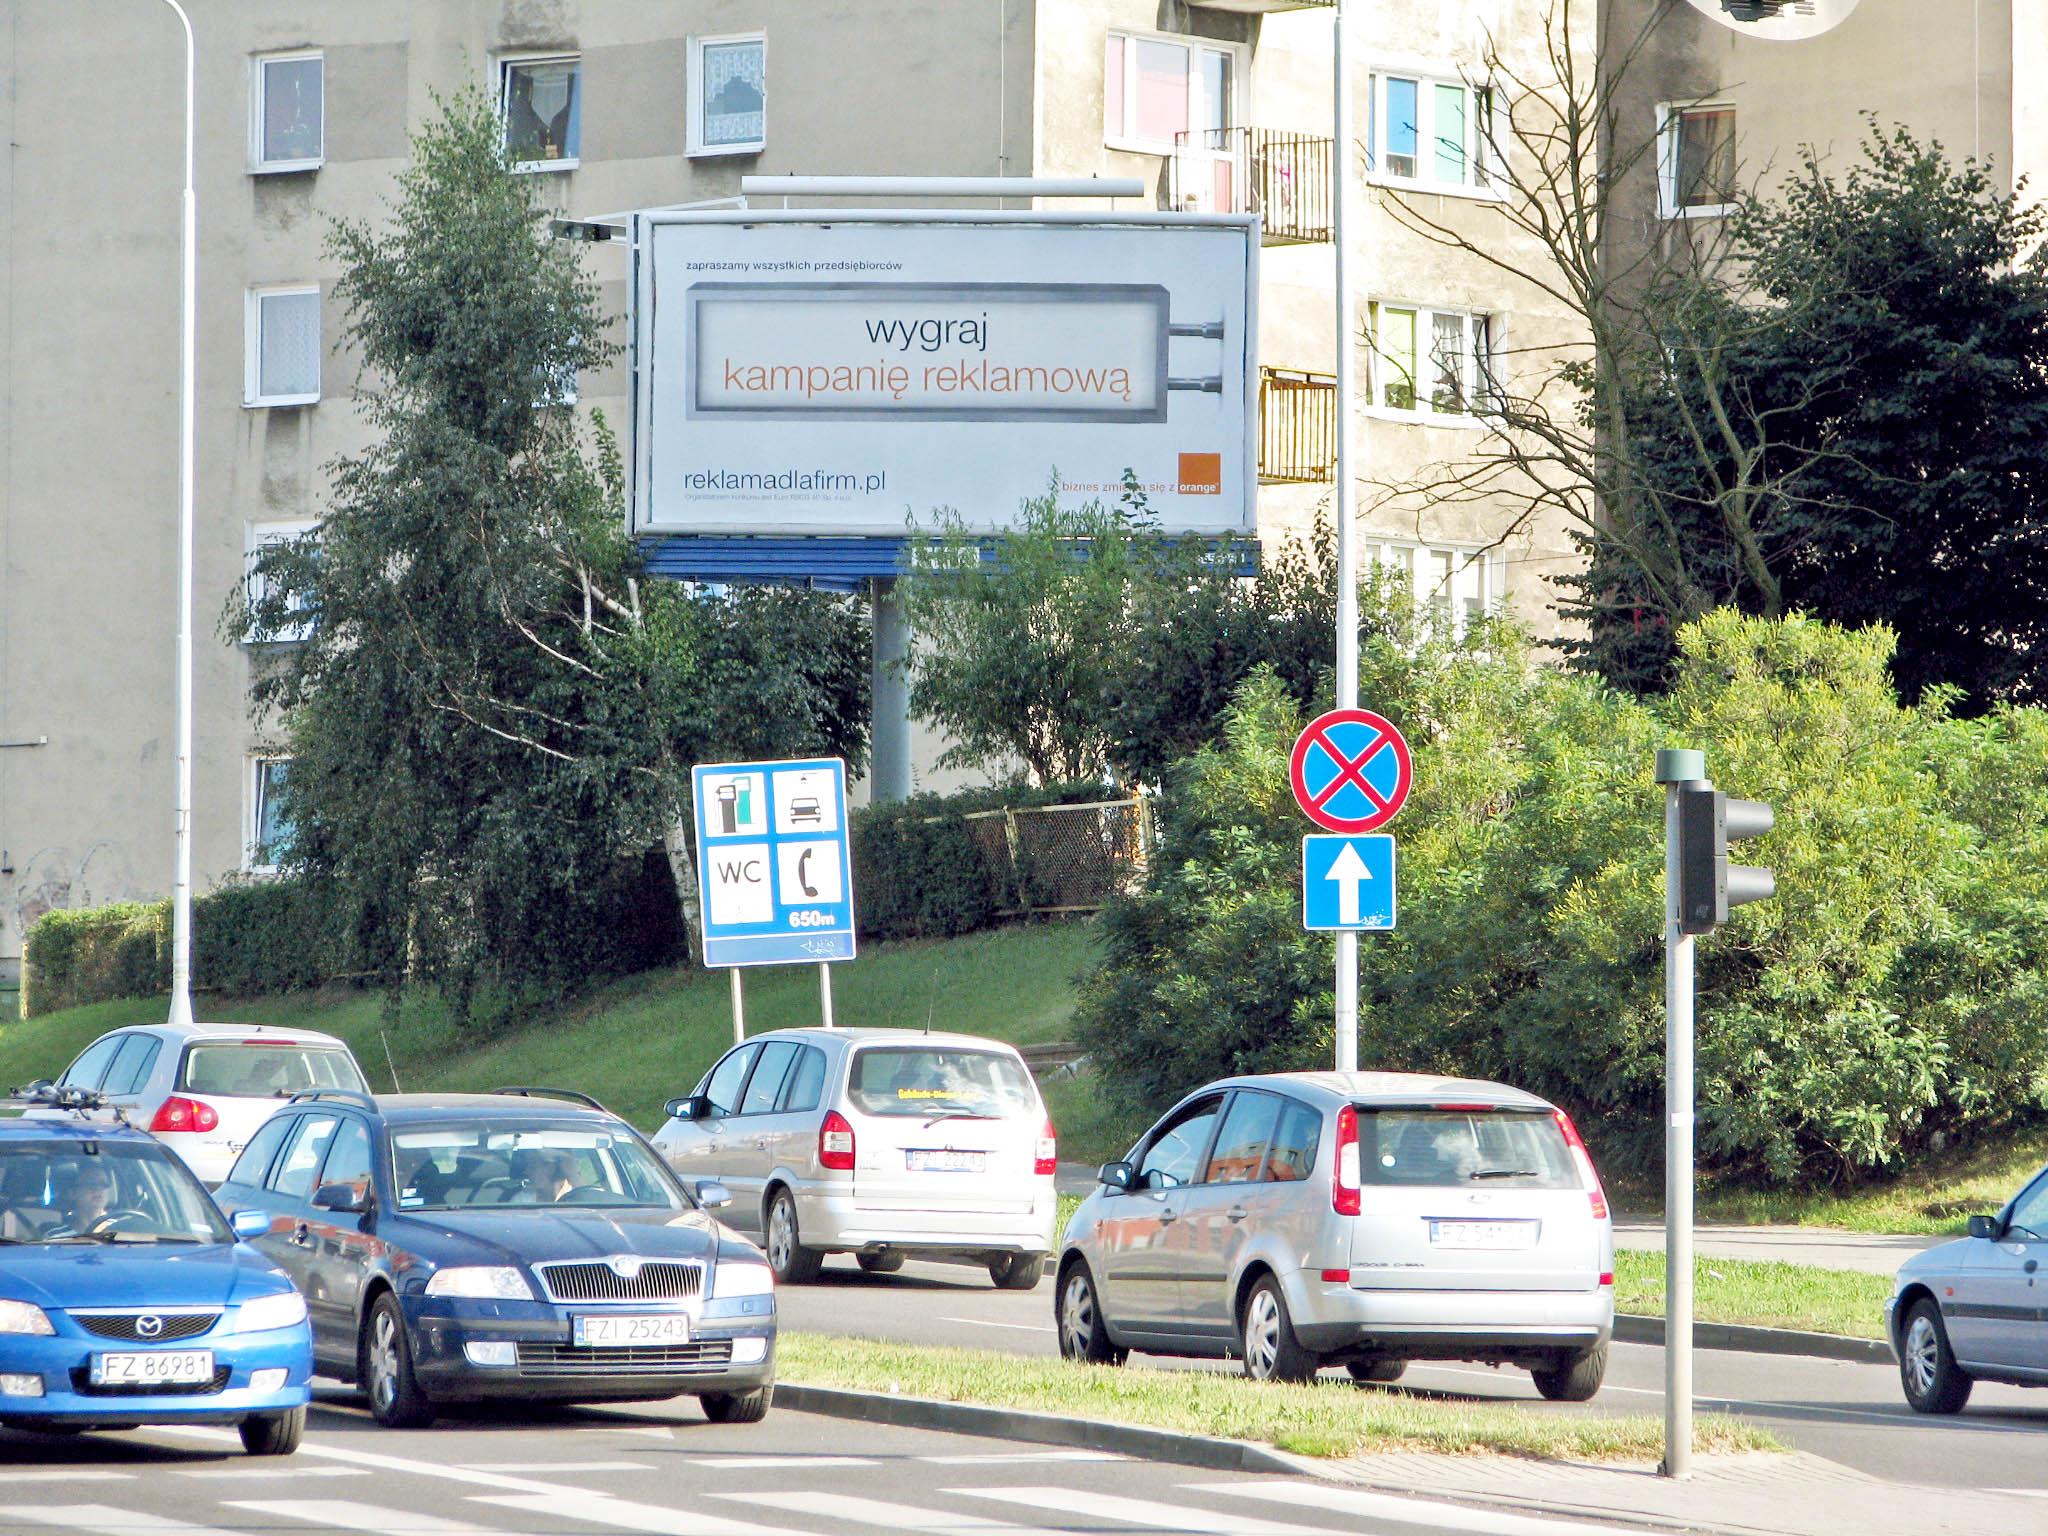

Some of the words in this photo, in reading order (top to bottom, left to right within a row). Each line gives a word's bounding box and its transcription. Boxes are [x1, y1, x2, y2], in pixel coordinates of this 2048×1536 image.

[686, 262, 749, 271] zapraszamy
[753, 260, 811, 270] wszystkich
[814, 260, 903, 271] przedsiębiorców
[865, 312, 988, 352] wygraj
[724, 358, 910, 400] kampanię
[924, 359, 1132, 402] reklamową
[684, 469, 886, 495] reklamadlafirm.pl
[1062, 481, 1099, 492] biznes
[1150, 481, 1166, 494] się
[1168, 483, 1175, 492] z
[1180, 483, 1216, 494] orange
[717, 860, 761, 884] WC
[788, 910, 836, 928] 650m
[586, 1320, 617, 1340] FZI
[629, 1319, 684, 1339] 25243
[106, 1356, 136, 1377] FZ
[145, 1355, 206, 1376] 86981
